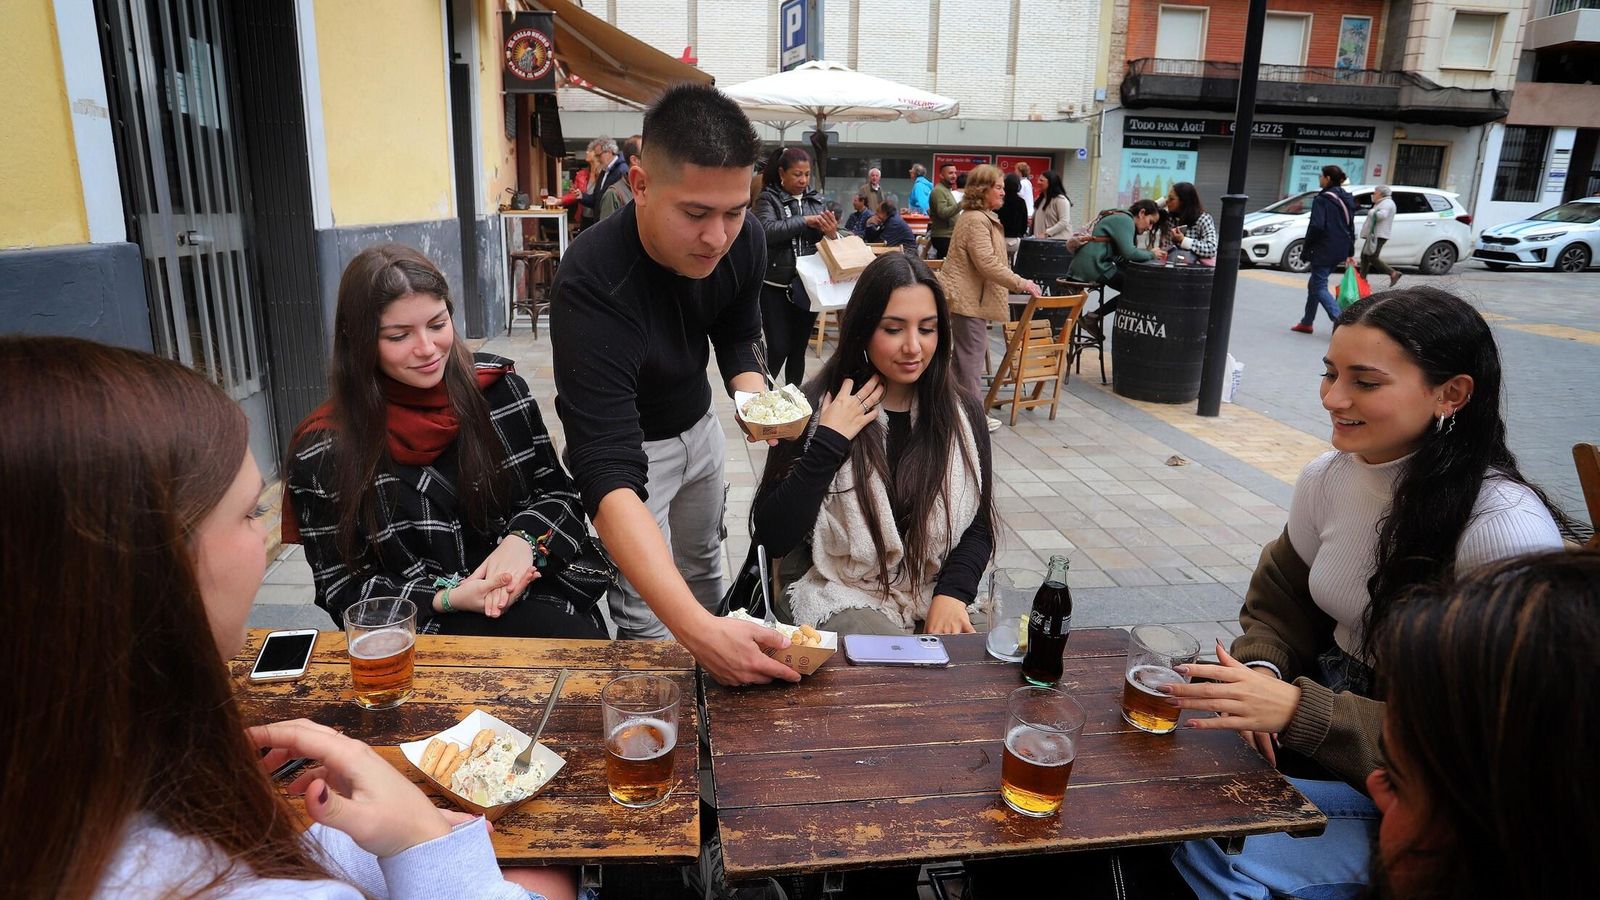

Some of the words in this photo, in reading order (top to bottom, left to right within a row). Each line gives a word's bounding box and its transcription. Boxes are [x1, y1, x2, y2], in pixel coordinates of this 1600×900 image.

[786, 5, 802, 48] P
[508, 40, 515, 48] EL
[513, 31, 531, 41] GALLO
[531, 31, 550, 47] NEGRO
[1260, 124, 1271, 133] 57
[1272, 125, 1284, 134] 75
[1117, 314, 1166, 338] GITANA
